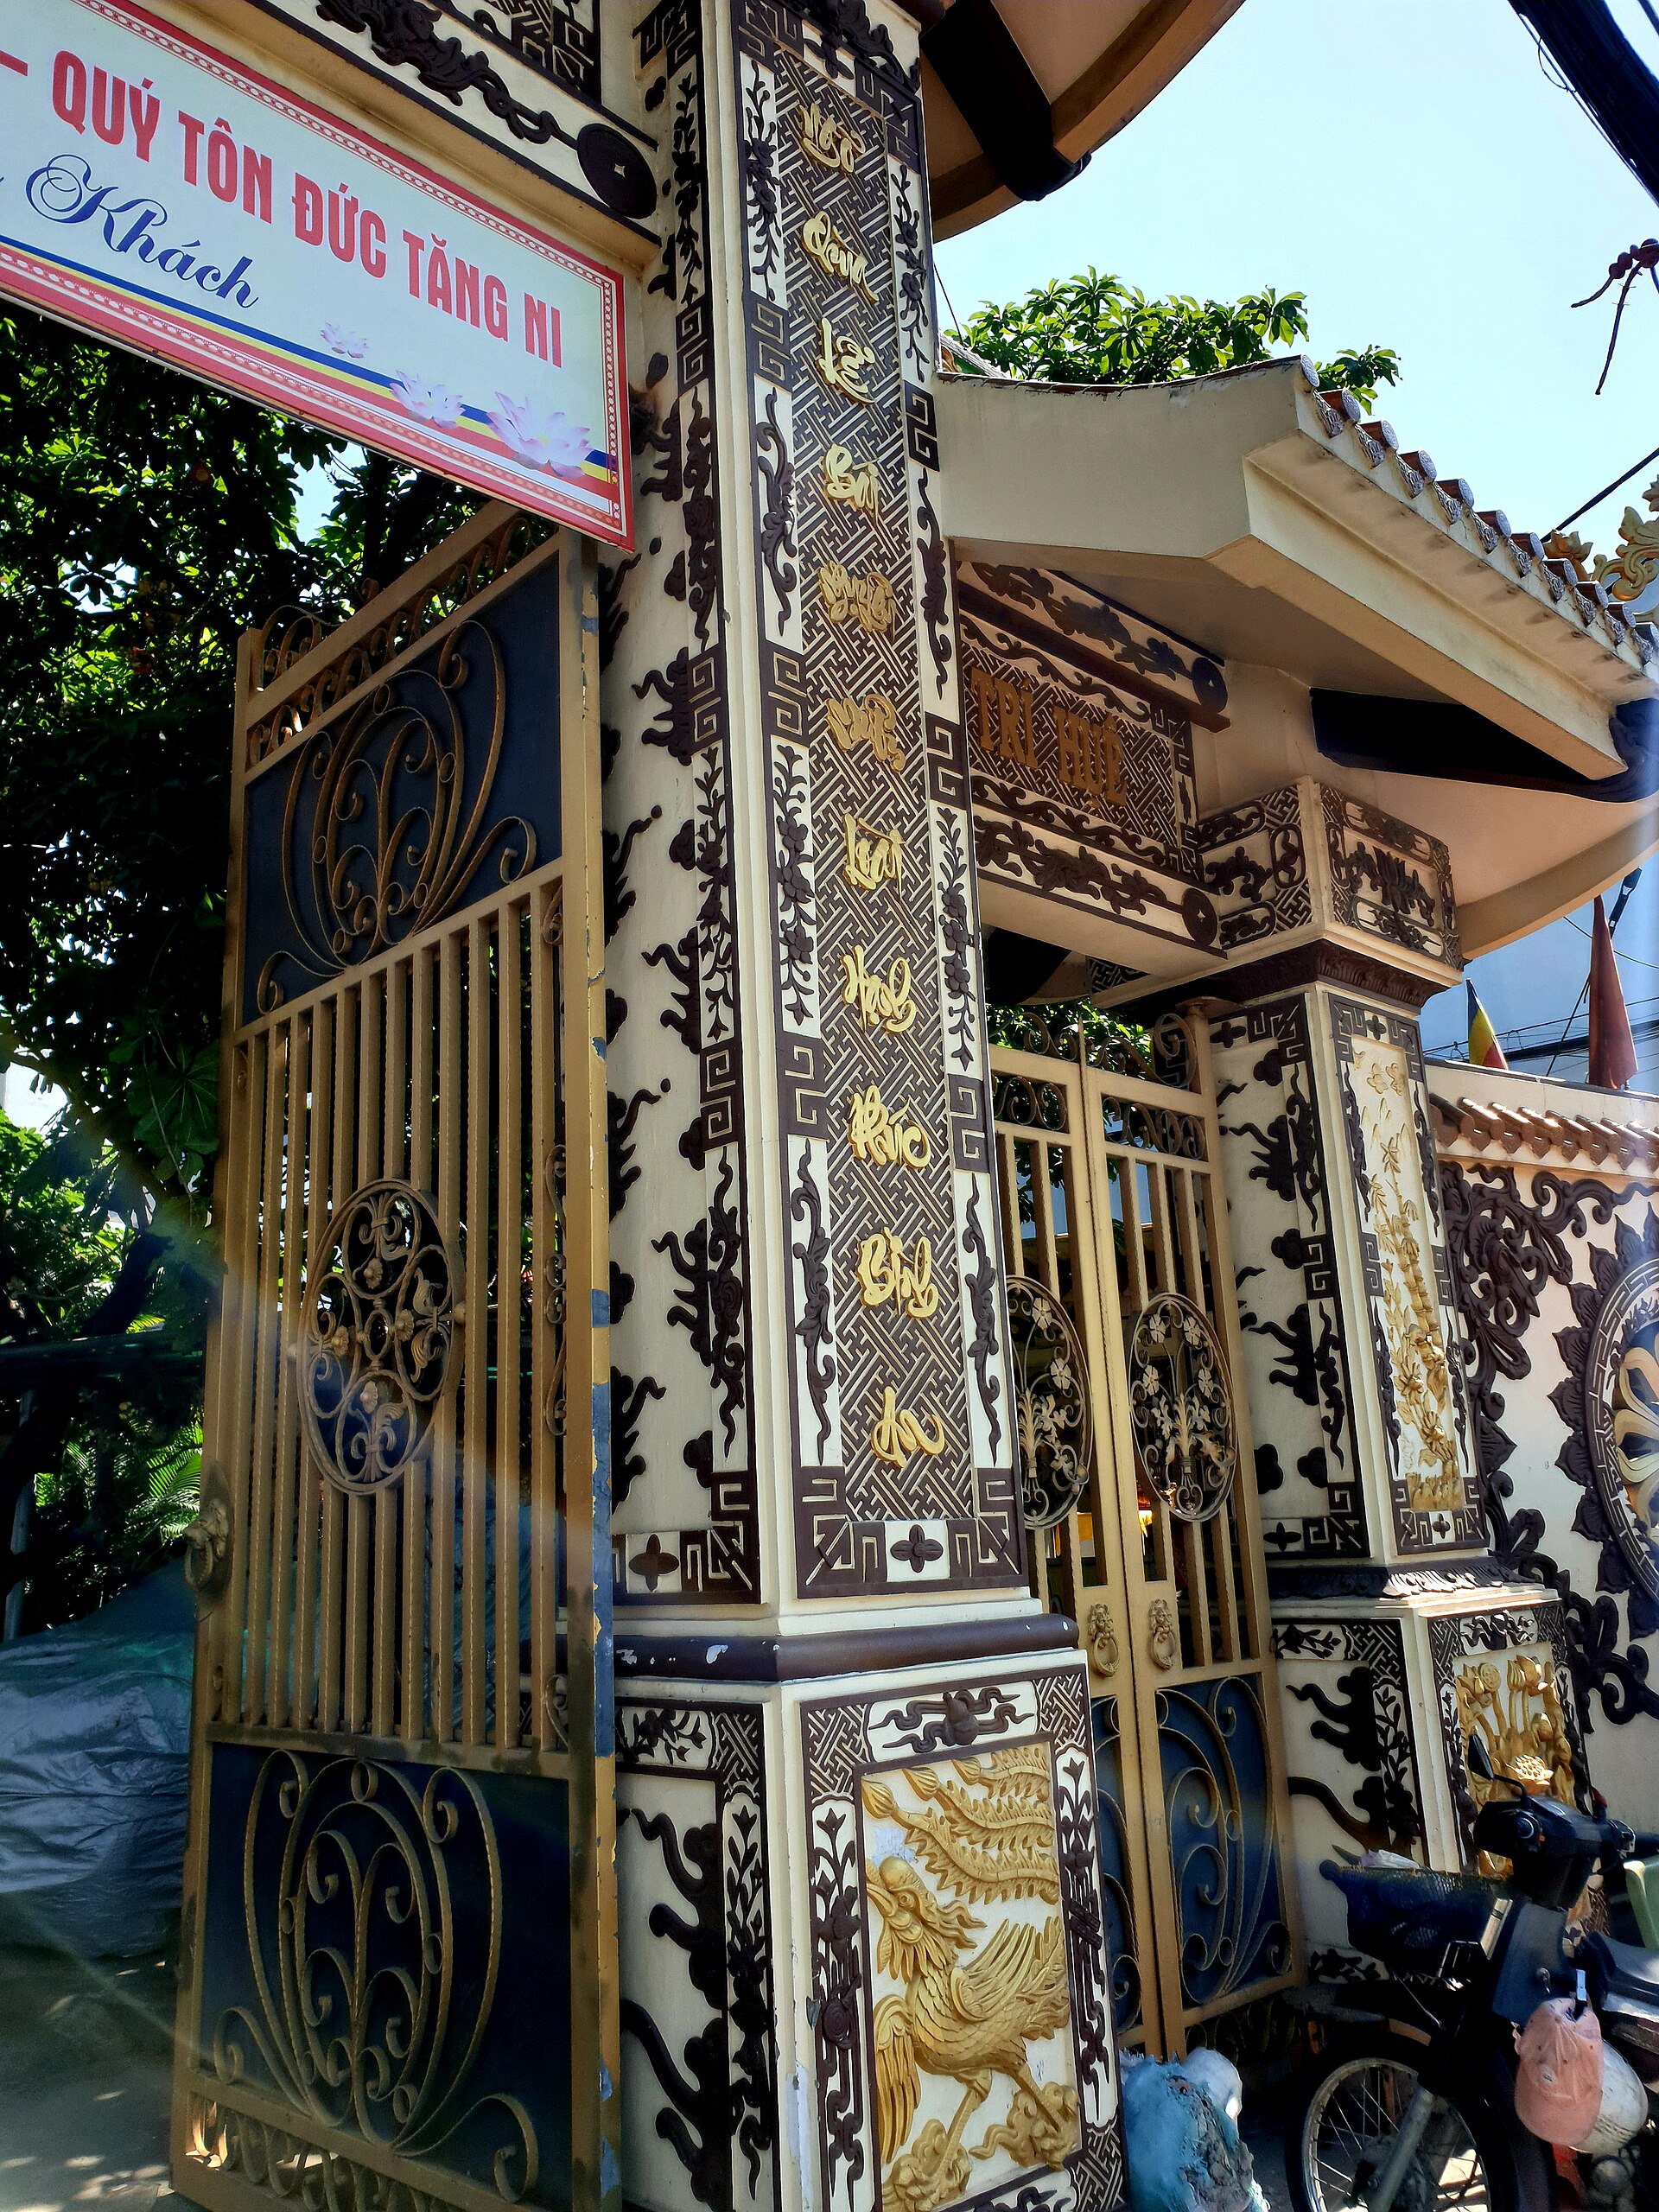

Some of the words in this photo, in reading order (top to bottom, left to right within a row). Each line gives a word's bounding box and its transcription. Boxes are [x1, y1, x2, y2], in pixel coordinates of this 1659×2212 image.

[26, 154, 259, 308] Khách
[52, 50, 160, 162] QUÝ
[178, 111, 272, 224] TÔN
[292, 173, 386, 279] ĐỨC
[402, 230, 508, 343] TĂNG
[523, 293, 563, 369] NI
[969, 667, 1038, 770] TRÍ
[1052, 711, 1127, 809] HUỆ
[840, 945, 917, 1033] Hạnh
